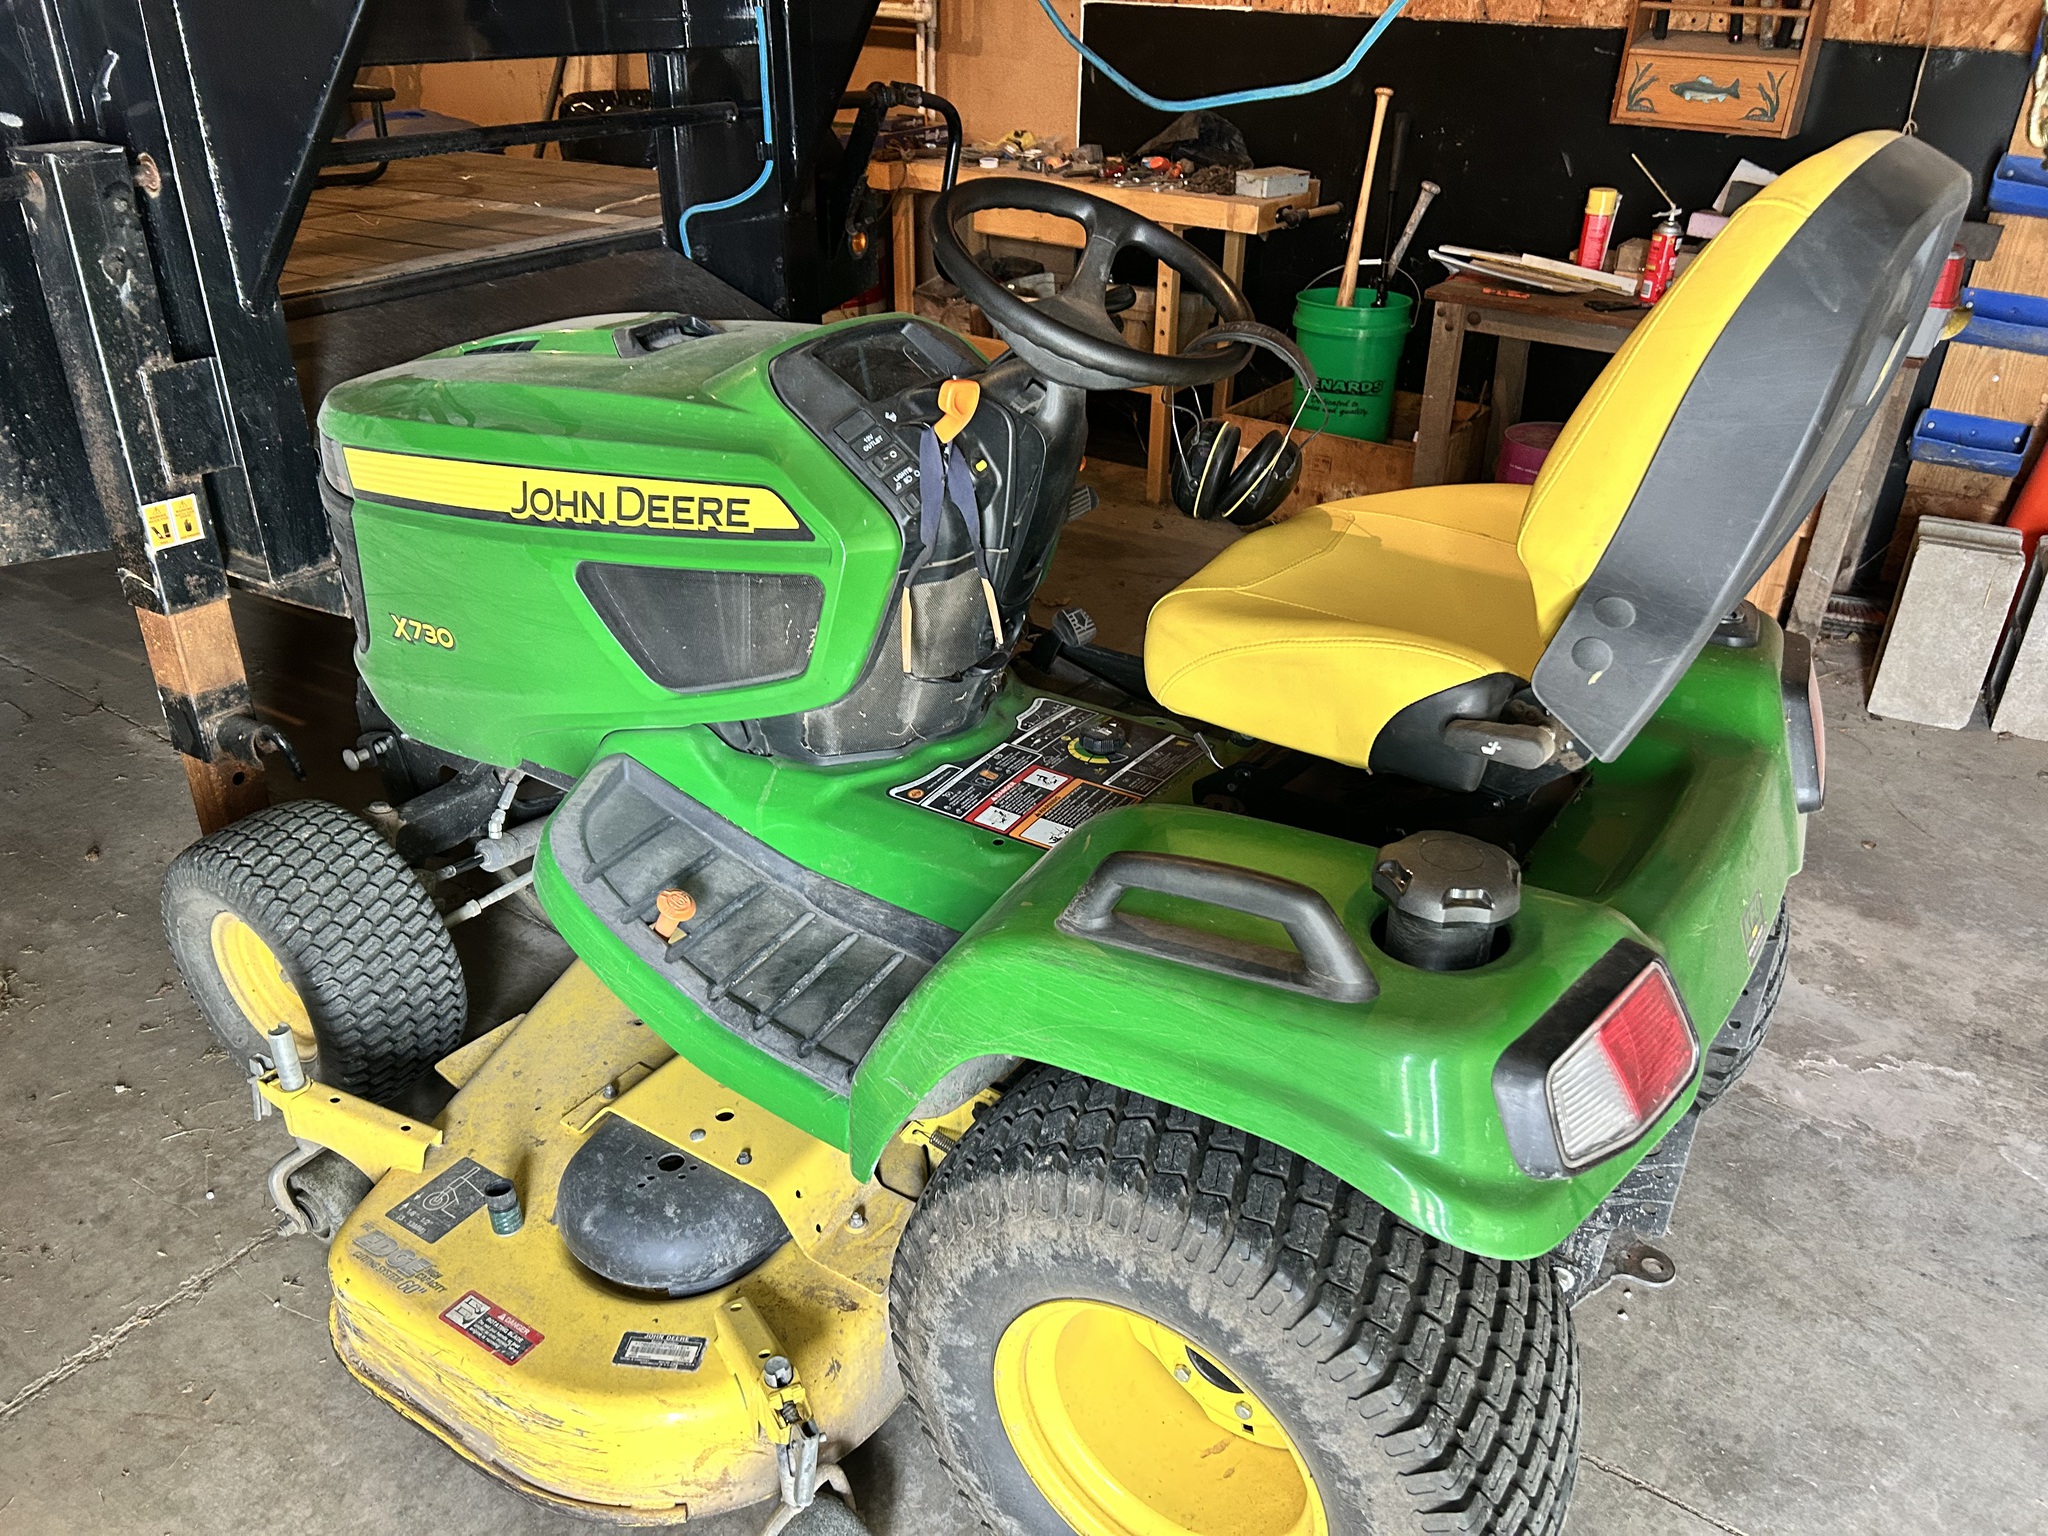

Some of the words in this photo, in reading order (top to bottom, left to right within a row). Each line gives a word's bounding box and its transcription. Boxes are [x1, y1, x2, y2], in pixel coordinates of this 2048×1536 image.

[1298, 377, 1384, 394] ENARDS
[863, 433, 874, 443] 12V
[863, 435, 883, 452] OUTLET
[893, 466, 913, 482] LIGHTS
[511, 481, 605, 519] JOHN
[617, 485, 751, 527] DEERE
[388, 612, 455, 650] X730
[352, 1229, 436, 1279] EDGE
[352, 1250, 380, 1270] CUTTING
[375, 1265, 404, 1284] SYSTEM
[414, 1271, 448, 1293] CAPACITY
[485, 1316, 510, 1334] ROTATING
[508, 1330, 524, 1344] BLADE
[505, 1316, 530, 1335] DANGER
